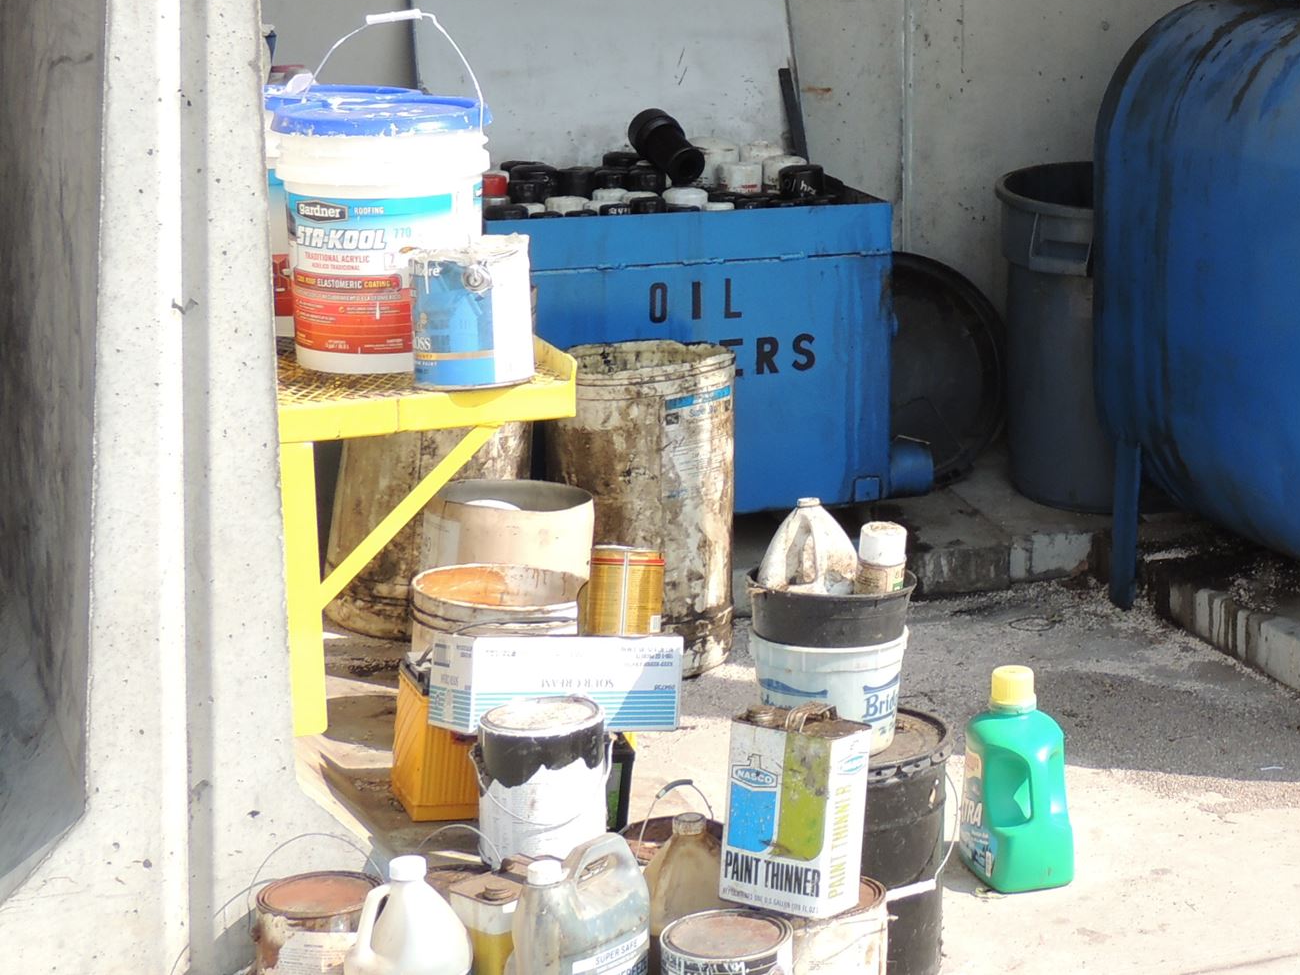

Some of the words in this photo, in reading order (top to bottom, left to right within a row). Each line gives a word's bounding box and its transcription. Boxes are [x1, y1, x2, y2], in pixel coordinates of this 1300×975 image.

[299, 203, 341, 218] gardner
[354, 206, 385, 215] ROOFING
[297, 225, 387, 250] STA-KOOL
[304, 251, 339, 264] TRADITIONAL
[341, 254, 371, 264] ACRYLIC
[316, 277, 362, 289] ELASTOMERIC
[364, 279, 391, 288] COATING
[648, 278, 743, 324] OIL
[736, 768, 774, 785] NASCO
[724, 850, 761, 886] PAINT
[764, 859, 821, 898] THINNER
[828, 861, 848, 899] PAINT
[595, 948, 621, 965] SUPER
[621, 938, 638, 954] SAFE
